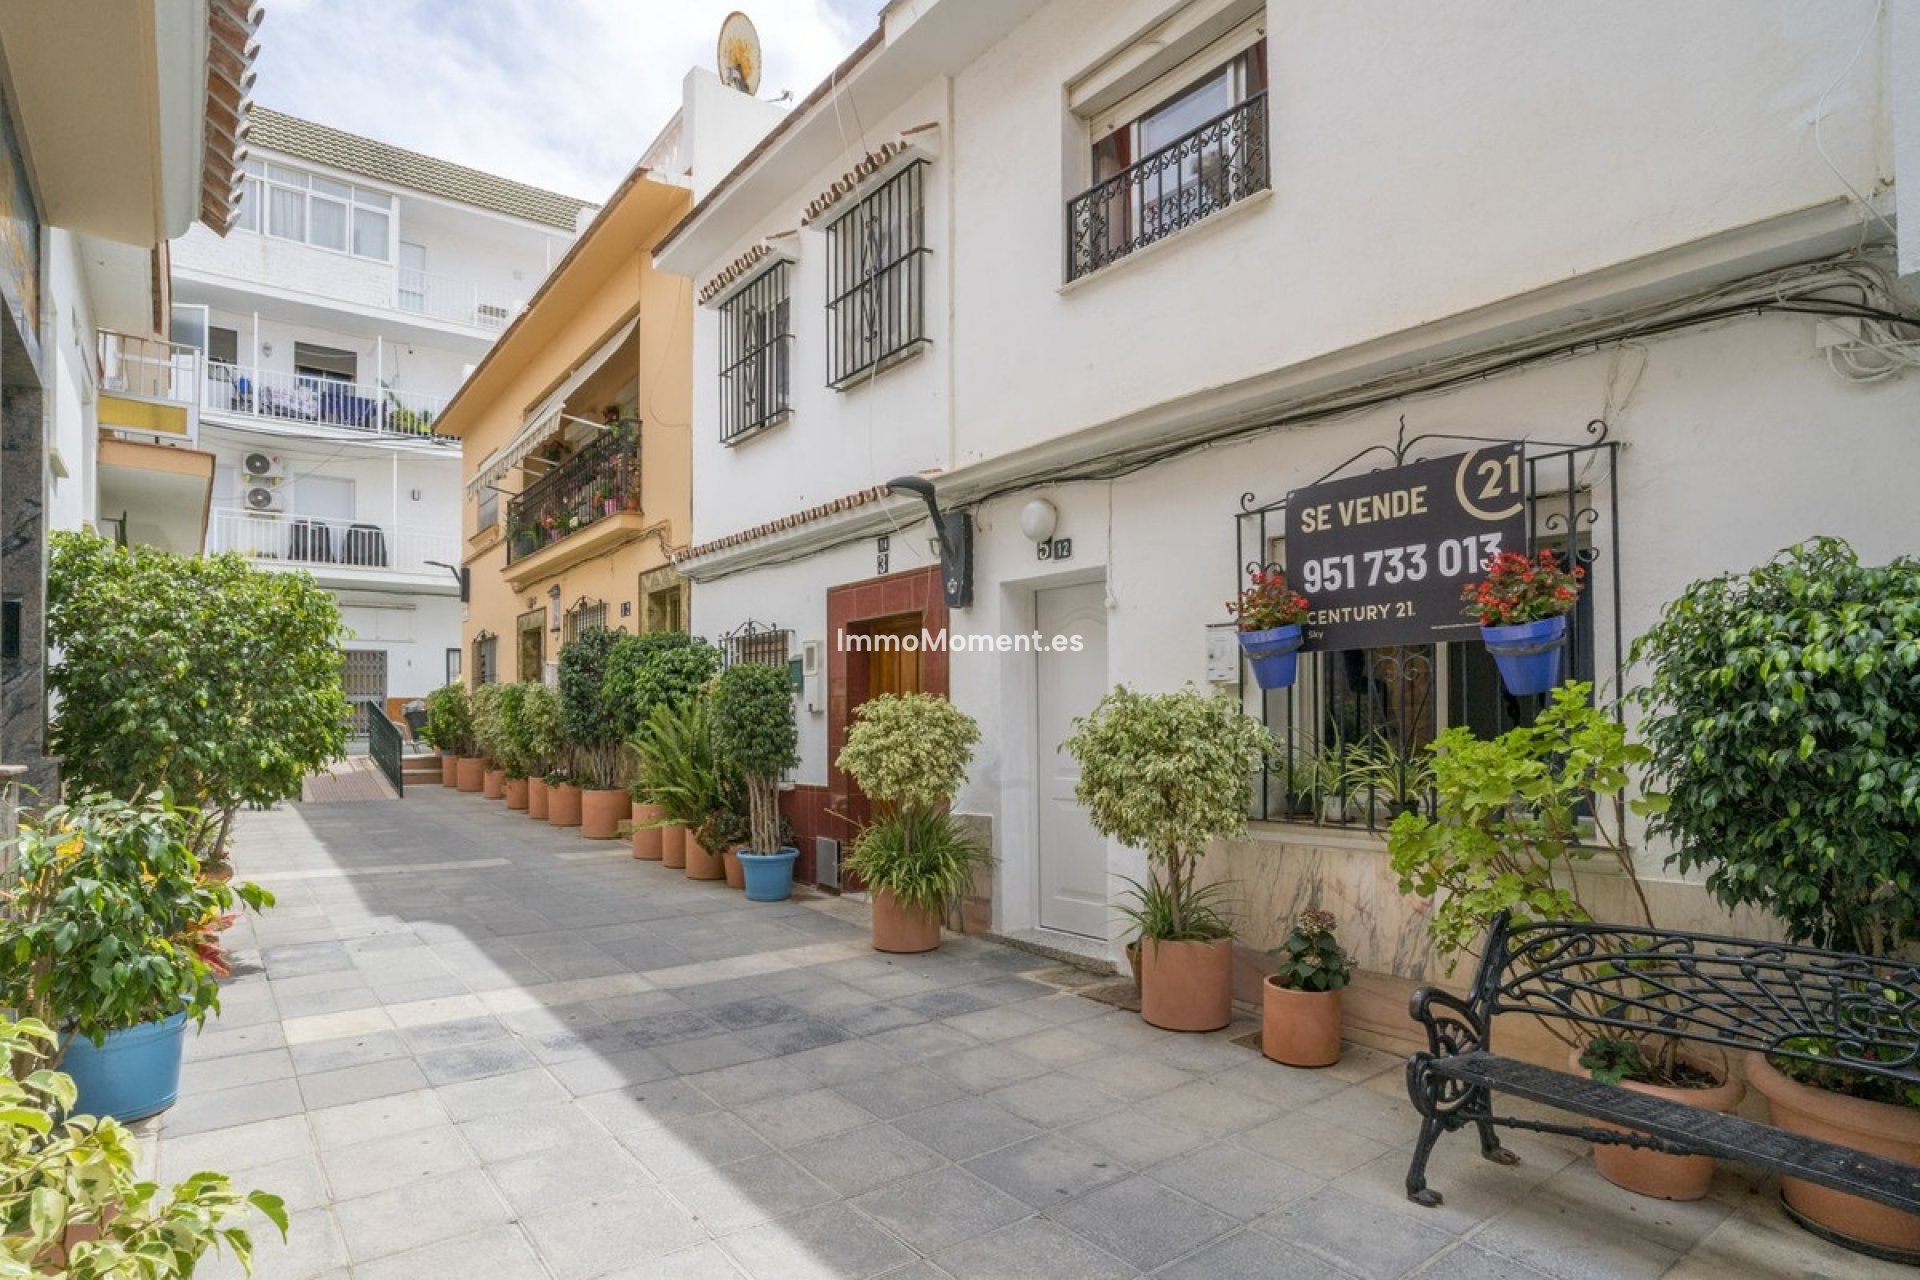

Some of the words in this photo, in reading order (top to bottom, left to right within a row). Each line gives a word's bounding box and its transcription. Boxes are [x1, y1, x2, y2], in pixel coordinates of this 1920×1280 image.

[1301, 503, 1332, 534] SE
[1338, 485, 1428, 527] VENDE
[1057, 541, 1070, 557] 12
[1303, 554, 1355, 594] 951
[1363, 543, 1428, 585] 733
[1438, 532, 1503, 577] 013
[1307, 602, 1391, 625] CENTURY
[1308, 629, 1324, 640] Sky
